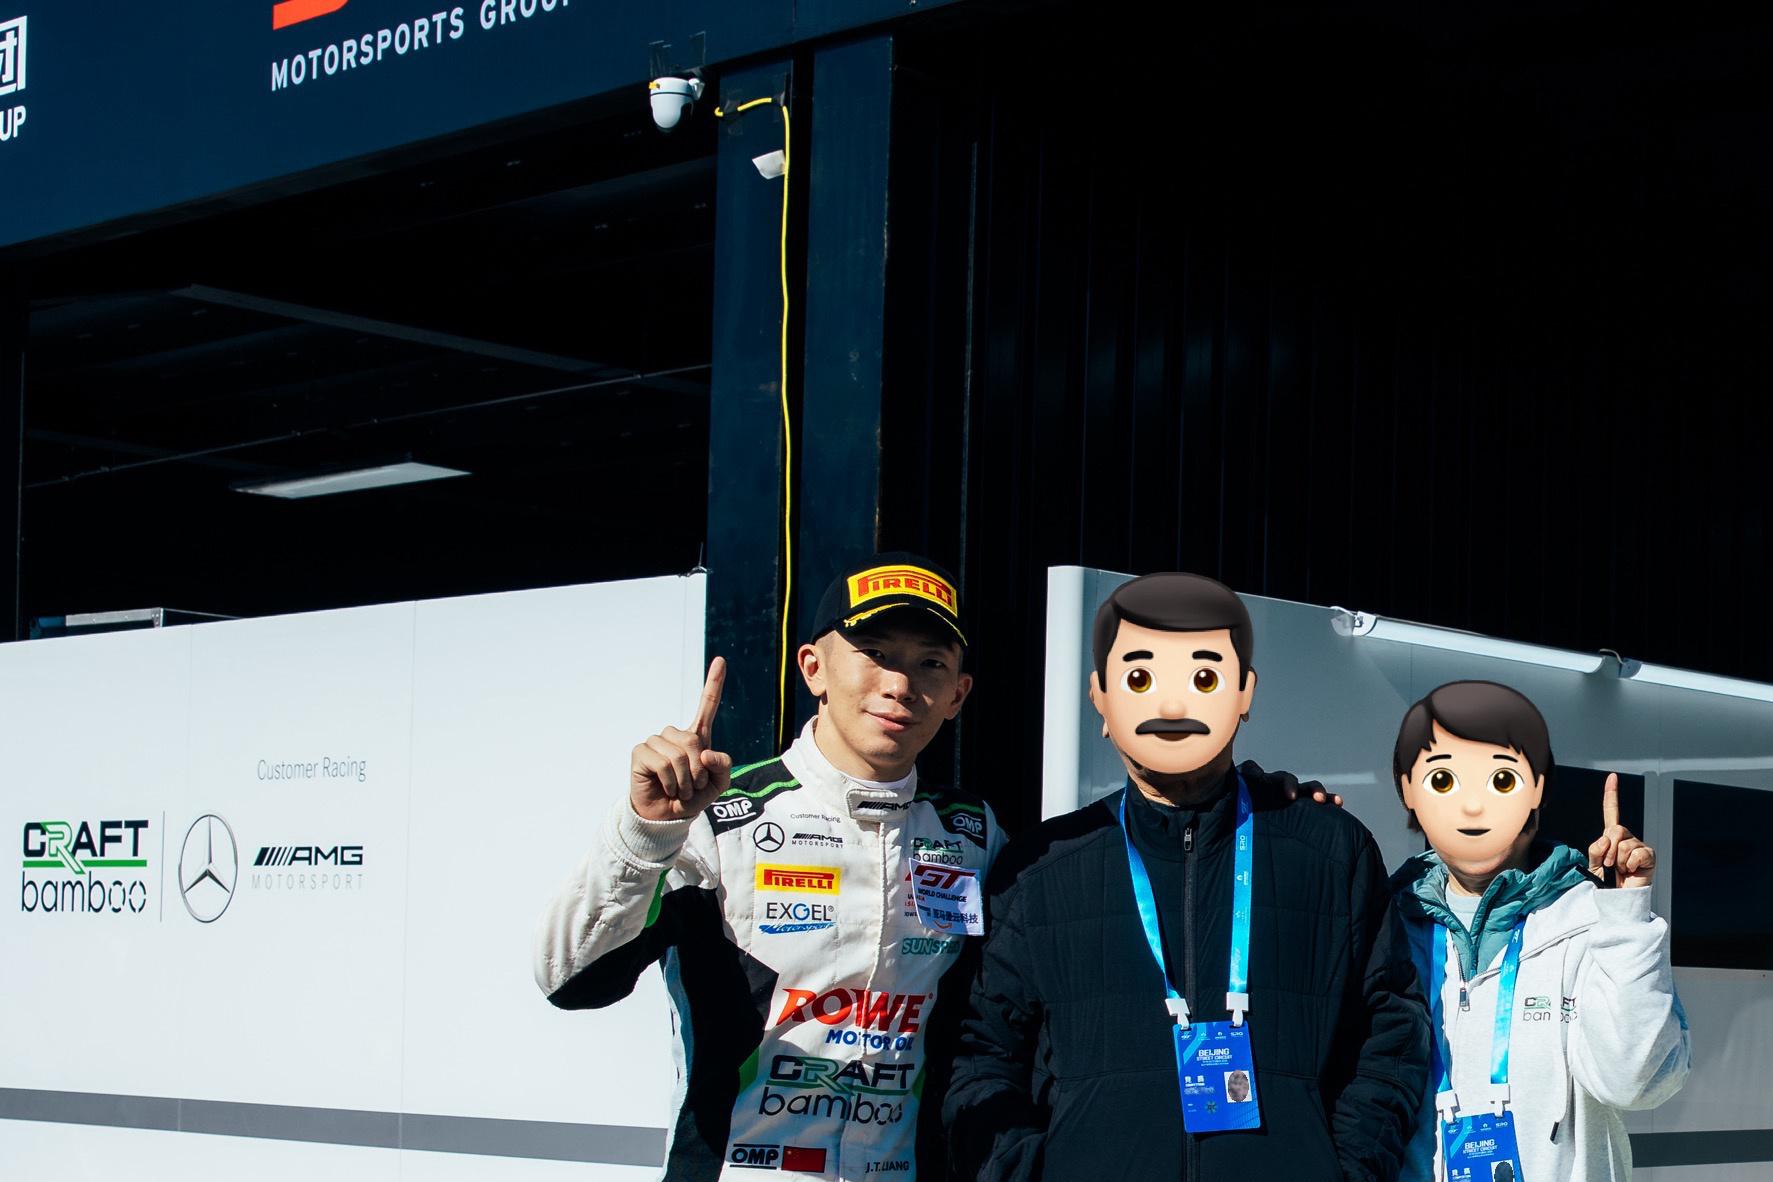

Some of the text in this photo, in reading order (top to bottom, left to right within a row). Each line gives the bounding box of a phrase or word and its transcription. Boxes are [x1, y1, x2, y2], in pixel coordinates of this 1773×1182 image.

[271, 0, 572, 91] MOTORSPORTS GRO
[857, 569, 953, 607] PIRELLI
[257, 755, 367, 783] Customer Racing
[713, 799, 753, 819] OMP
[953, 816, 984, 836] OMP
[23, 819, 149, 875] CRAFT
[791, 840, 844, 849] MOTORSPORT
[809, 833, 844, 844] AMG
[287, 845, 363, 866] AMG
[251, 872, 365, 890] MOTORSPORT
[764, 869, 835, 890] PIRELLI
[21, 870, 147, 913] bamboo
[918, 887, 936, 899] WORLD
[936, 892, 968, 903] CHALLENGE
[775, 987, 926, 1034] ROWE
[825, 1029, 891, 1051] MOTOR
[1198, 1047, 1230, 1057] BEIJING
[769, 1054, 915, 1092] CRAFT
[1464, 1139, 1495, 1150] BEIJING
[732, 1148, 779, 1165] OMP
